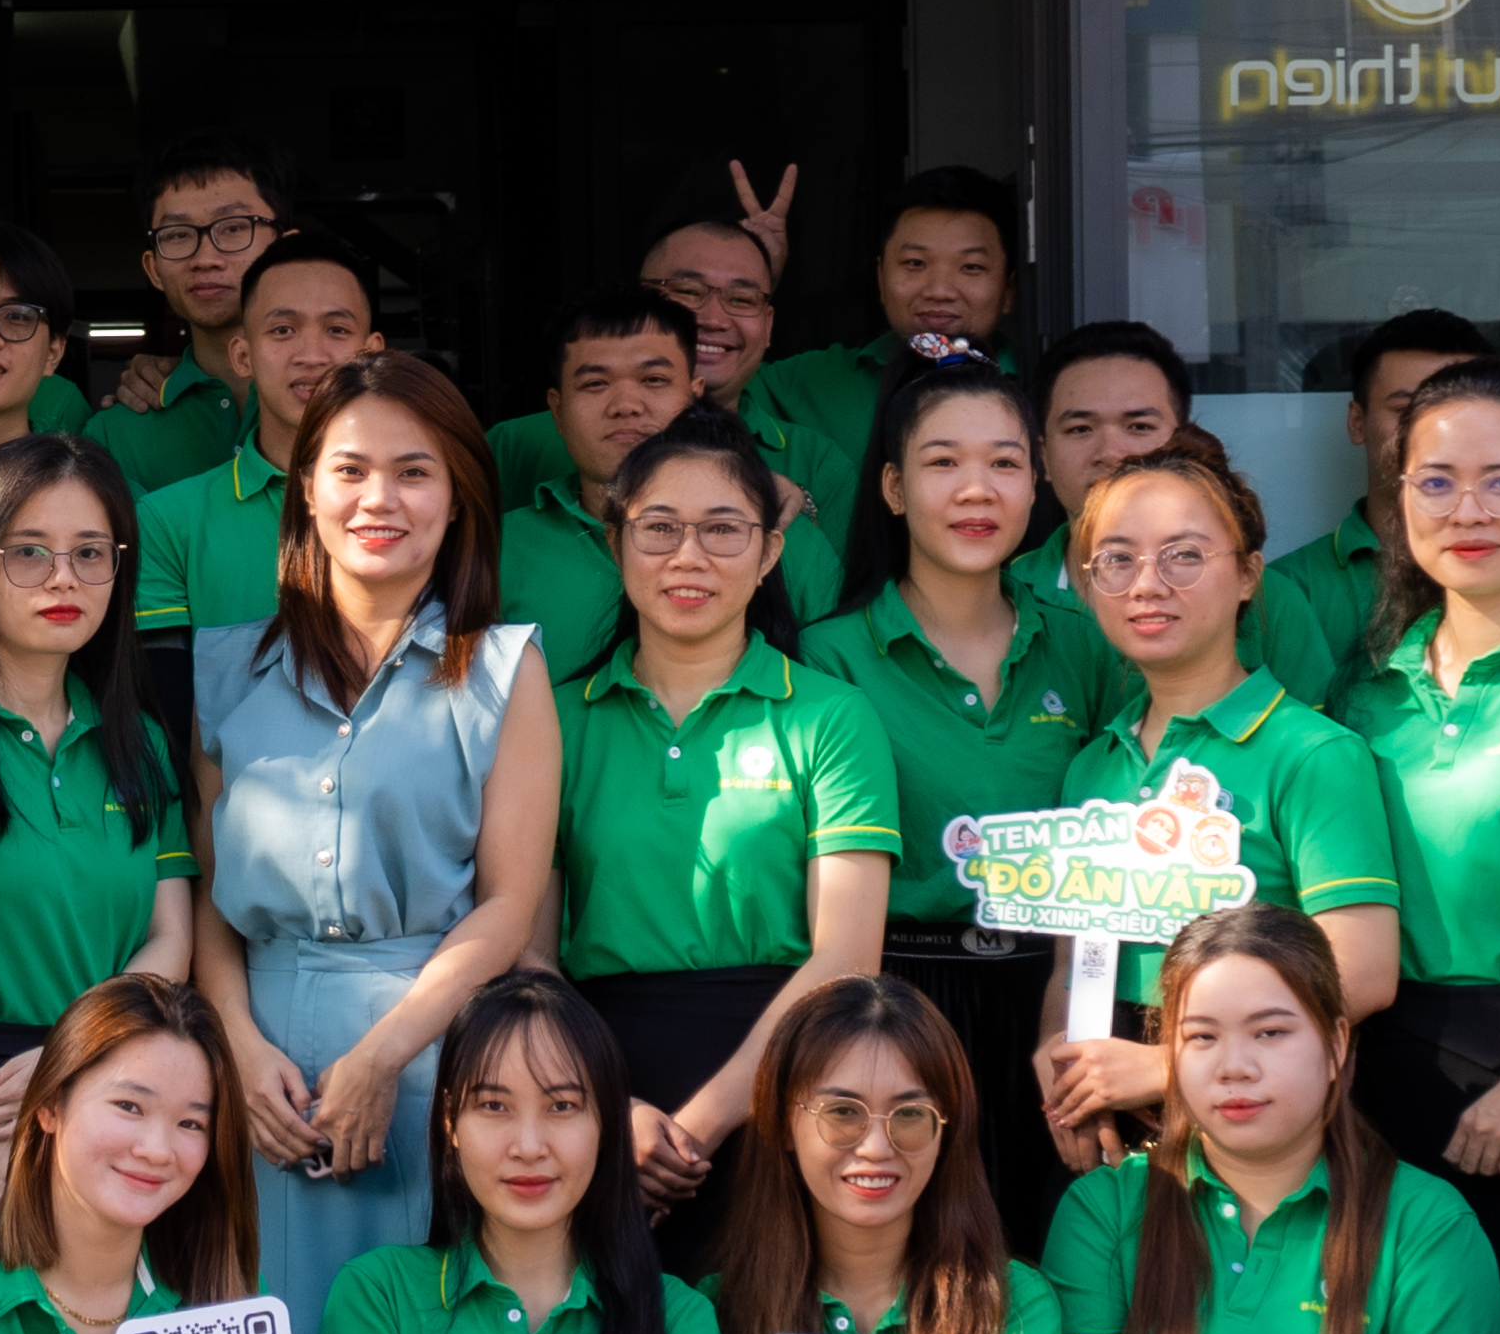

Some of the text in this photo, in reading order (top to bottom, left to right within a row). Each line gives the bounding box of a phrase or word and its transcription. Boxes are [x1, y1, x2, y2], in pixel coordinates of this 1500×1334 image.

[987, 824, 1050, 851] TEM
[1059, 812, 1127, 844] DÁN
[1062, 859, 1124, 903] ĂN
[984, 901, 1156, 934] SIÊU XINH SIÊU
